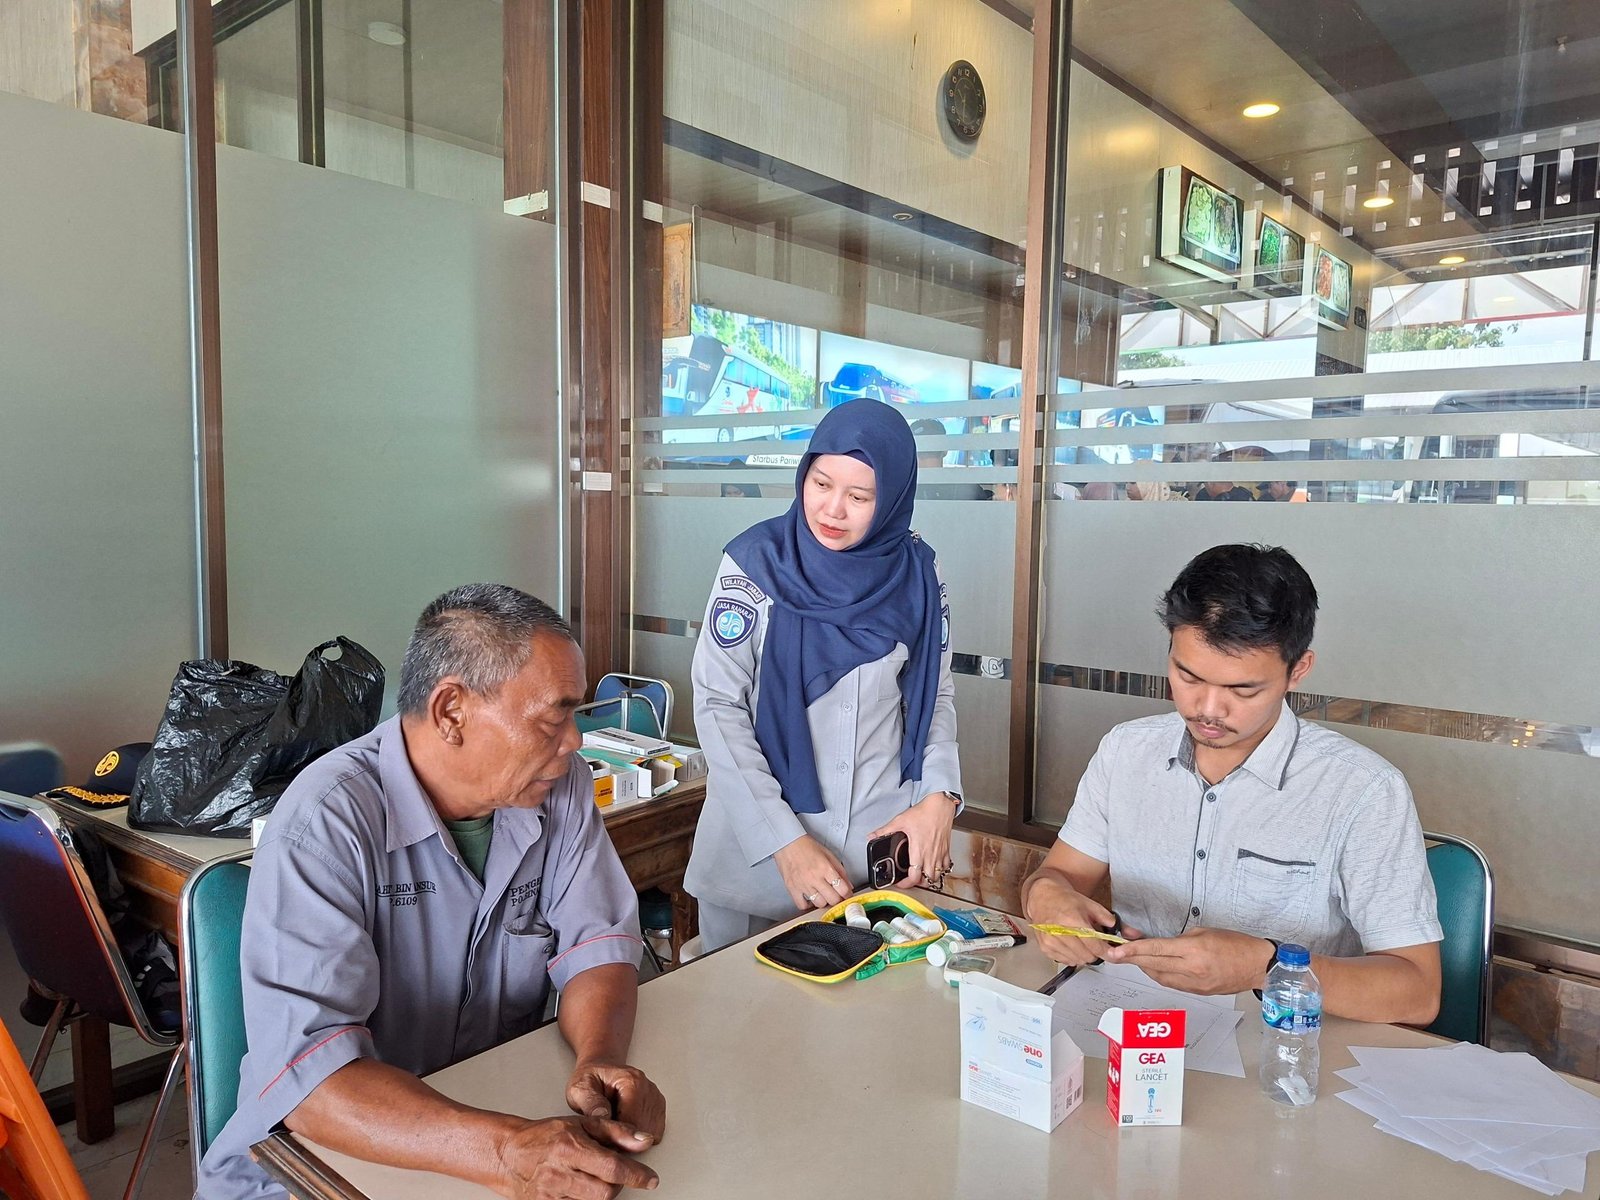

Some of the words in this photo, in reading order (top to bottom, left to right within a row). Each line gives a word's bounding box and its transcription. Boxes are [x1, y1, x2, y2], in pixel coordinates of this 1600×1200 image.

[752, 455, 778, 464] Starbus
[780, 455, 800, 465] Pariw
[725, 579, 747, 587] WILAYAH
[747, 585, 761, 598] JABAR
[731, 604, 754, 620] RAHARJA
[395, 883, 412, 893] BIN
[1137, 1022, 1171, 1038] GEA
[1138, 1053, 1166, 1064] GEA
[1135, 1073, 1168, 1081] LANCET
